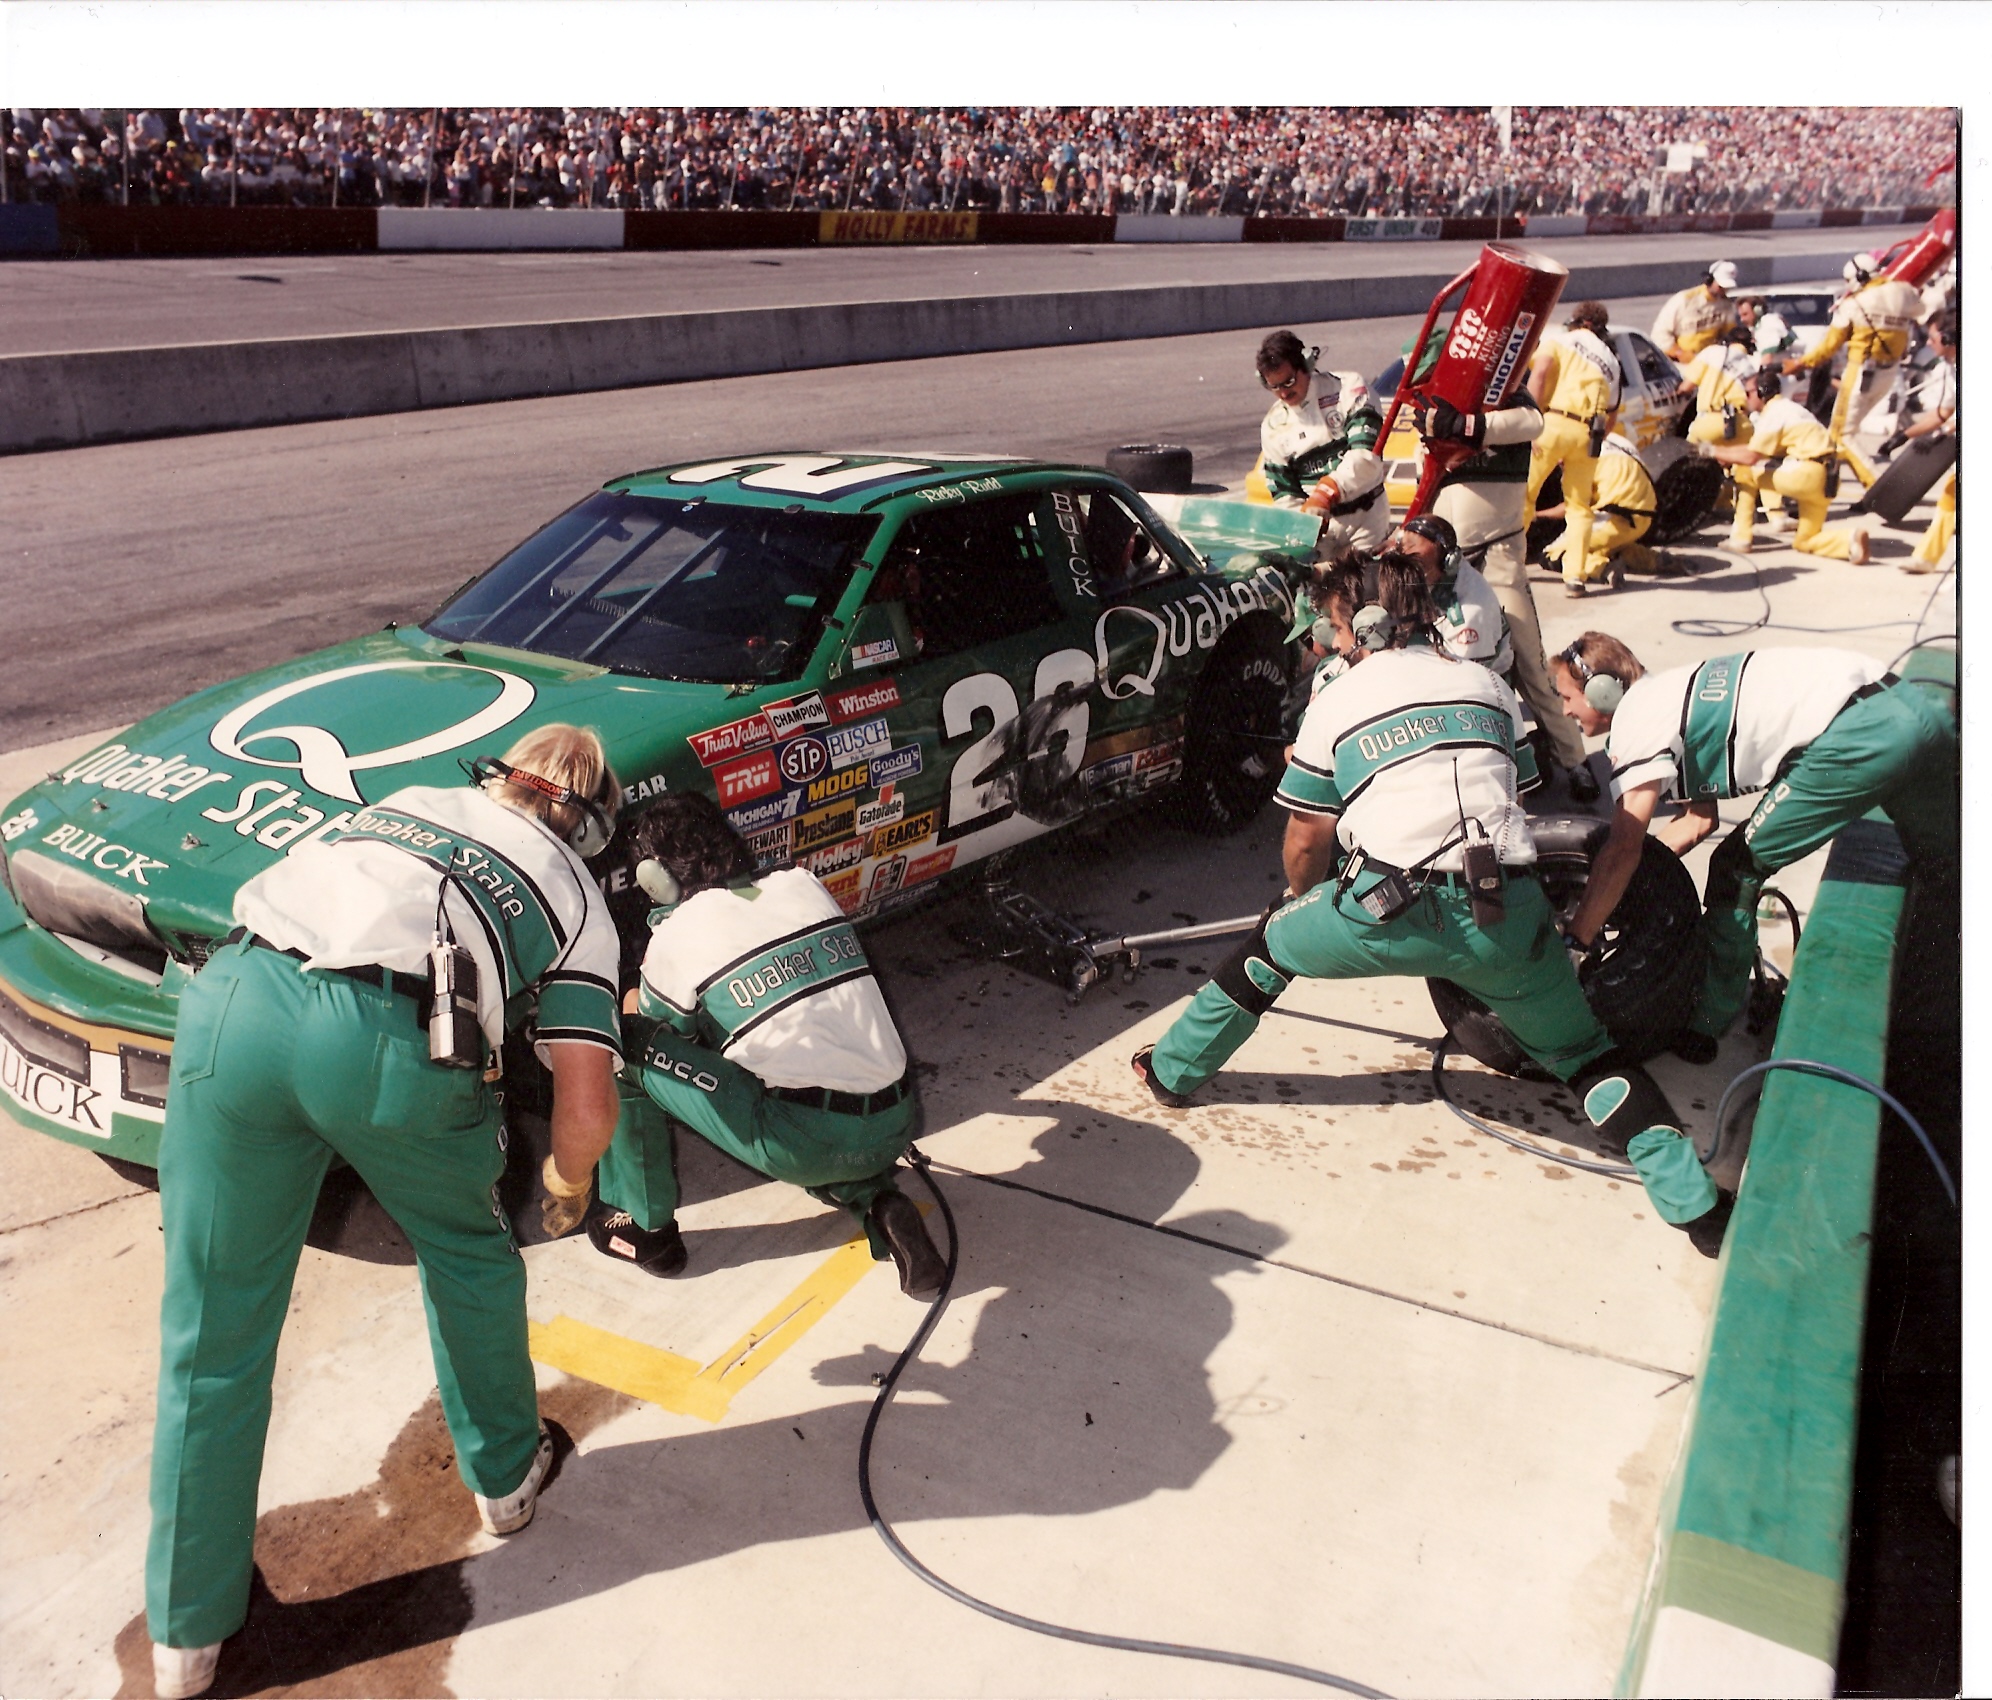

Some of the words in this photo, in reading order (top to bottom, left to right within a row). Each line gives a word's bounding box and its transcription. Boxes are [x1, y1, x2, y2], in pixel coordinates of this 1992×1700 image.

[834, 215, 896, 241] HOLLY
[902, 215, 971, 240] FARMS
[1478, 329, 1498, 362] KING
[1484, 325, 1511, 373] RACING
[1486, 330, 1527, 404] UNOCAL
[915, 485, 966, 503] Ricky
[960, 476, 1004, 494] Rudd
[1051, 491, 1097, 597] BUICK
[864, 639, 893, 656] NASCAR
[772, 702, 824, 728] CHAMPION
[838, 687, 899, 716] Winston
[828, 720, 890, 757] BUSCH
[1357, 714, 1447, 762] Quaker
[1454, 709, 1507, 740] State
[787, 738, 821, 776] STP
[872, 749, 920, 775] Goody's
[511, 769, 563, 795] DAVIDSON
[722, 761, 771, 797] TRW
[807, 764, 868, 803] MOOG
[61, 743, 233, 803] Quaker
[200, 779, 355, 857] Stat
[728, 800, 783, 827] MICHIGAN
[781, 789, 802, 819] 77
[859, 800, 902, 826] Gatorade
[1, 808, 40, 842] 26
[748, 825, 790, 851] TEWART
[886, 815, 931, 847] EARL'S
[42, 824, 169, 886] BUICK
[346, 811, 453, 850] Quaker
[449, 847, 526, 922] State
[810, 841, 863, 874] Holley
[727, 947, 817, 1009] Quaker
[820, 933, 863, 964] Stat
